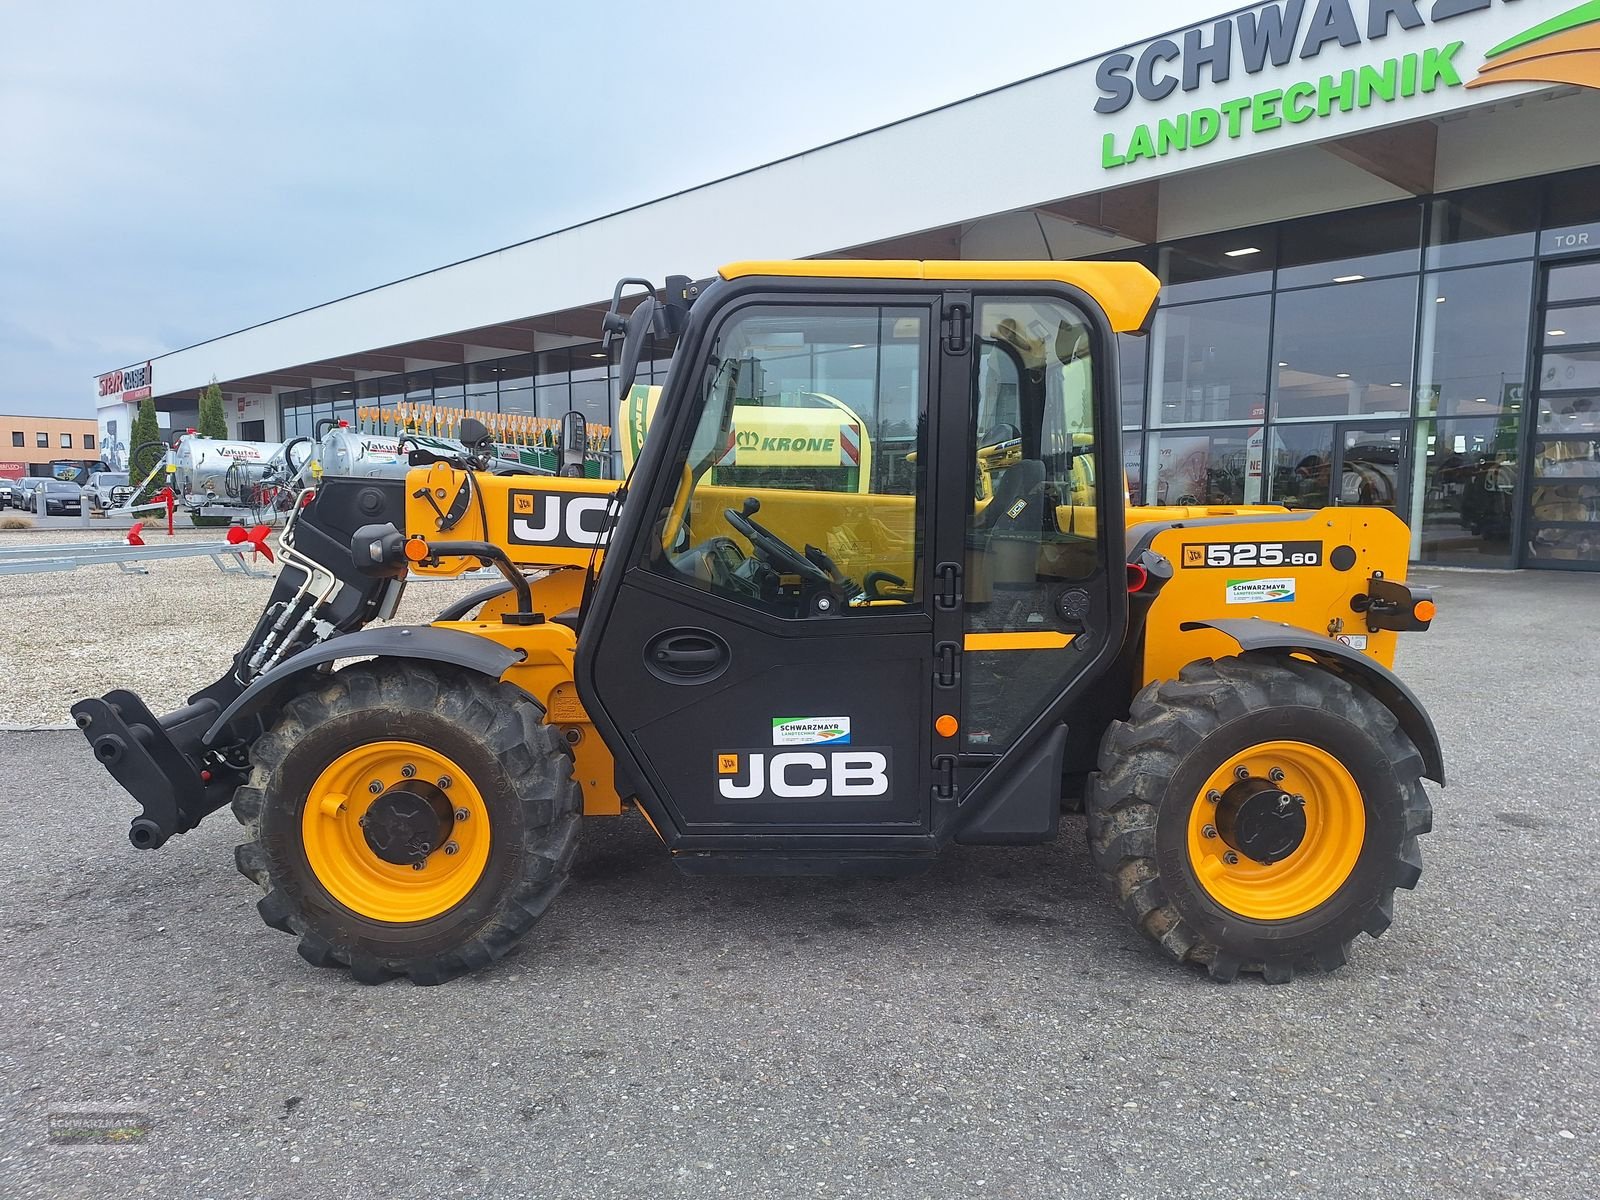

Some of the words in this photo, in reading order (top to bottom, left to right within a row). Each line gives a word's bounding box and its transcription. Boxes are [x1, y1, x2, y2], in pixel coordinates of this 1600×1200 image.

[1094, 0, 1521, 113] SCHWAR
[1102, 41, 1464, 168] LANDTECHNIK
[1554, 232, 1589, 248] TOR
[99, 371, 123, 397] STEYR
[124, 368, 144, 391] CASE
[216, 447, 260, 457] Vakutec
[361, 440, 409, 452] Vakutc
[761, 437, 835, 452] KRONE
[1207, 543, 1317, 566] 525-60
[719, 752, 889, 799] JCB
